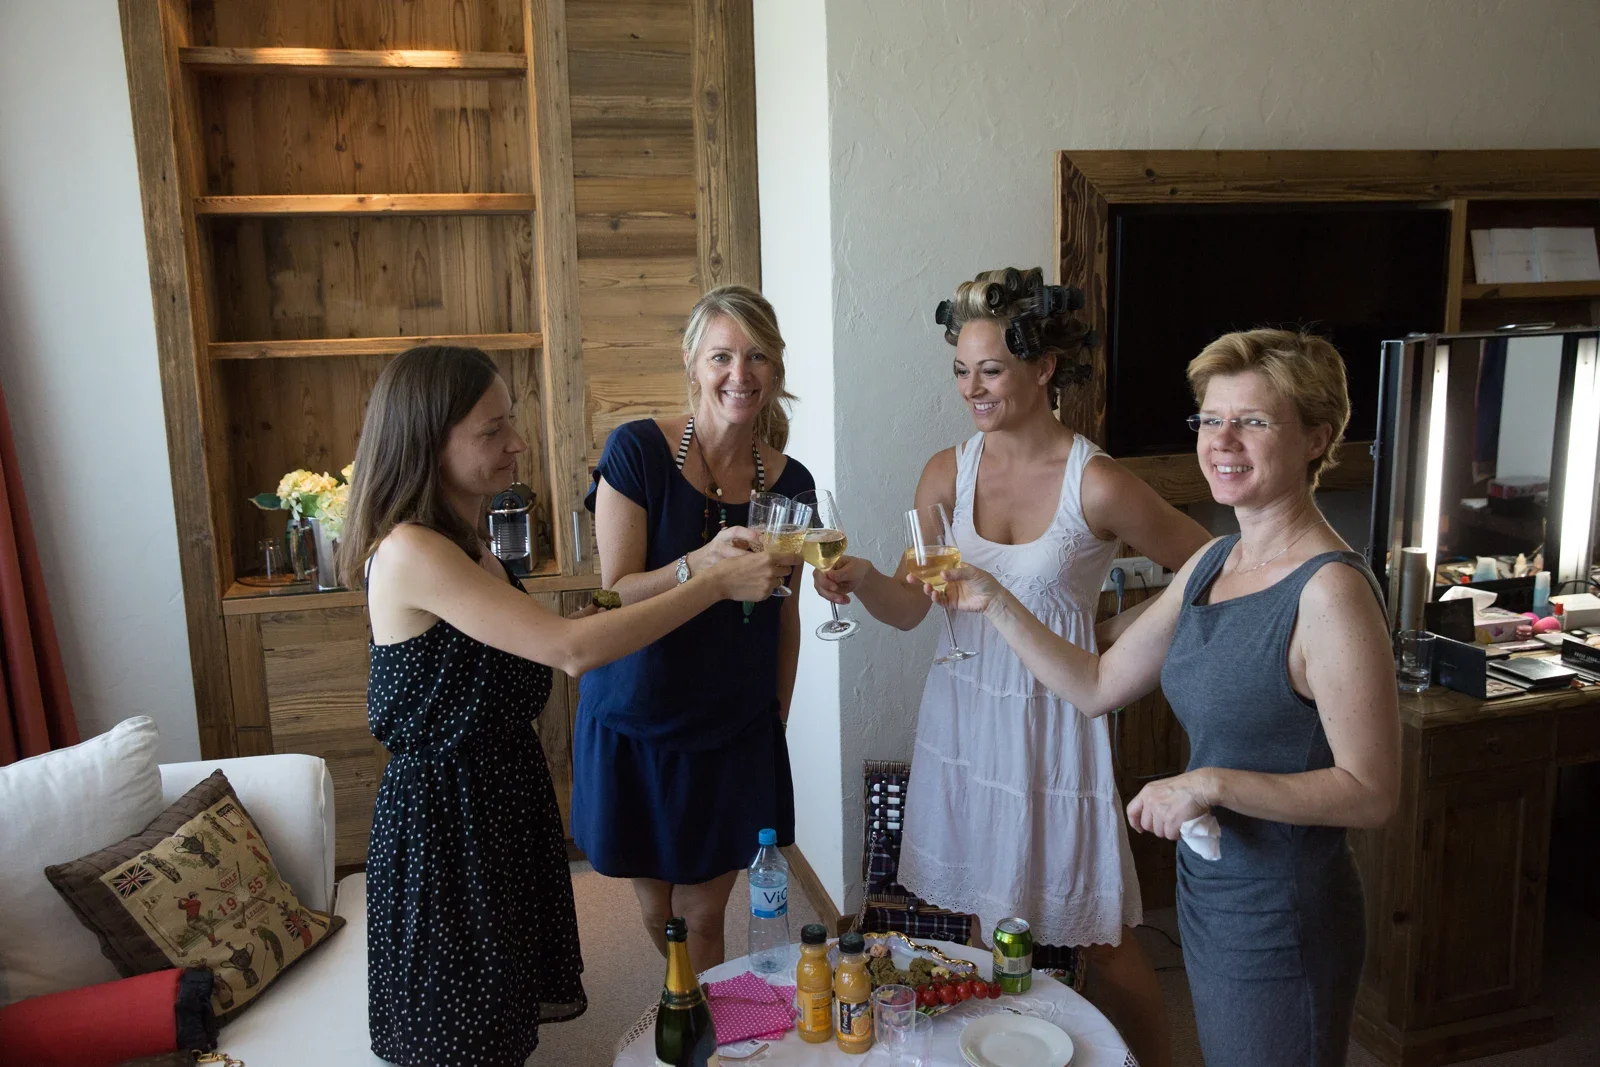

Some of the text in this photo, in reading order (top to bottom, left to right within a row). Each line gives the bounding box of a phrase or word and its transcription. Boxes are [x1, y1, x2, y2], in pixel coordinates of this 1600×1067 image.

[221, 872, 238, 889] GOLF
[217, 897, 238, 917] 19
[248, 876, 263, 894] 55
[246, 903, 265, 920] LEAGUE
